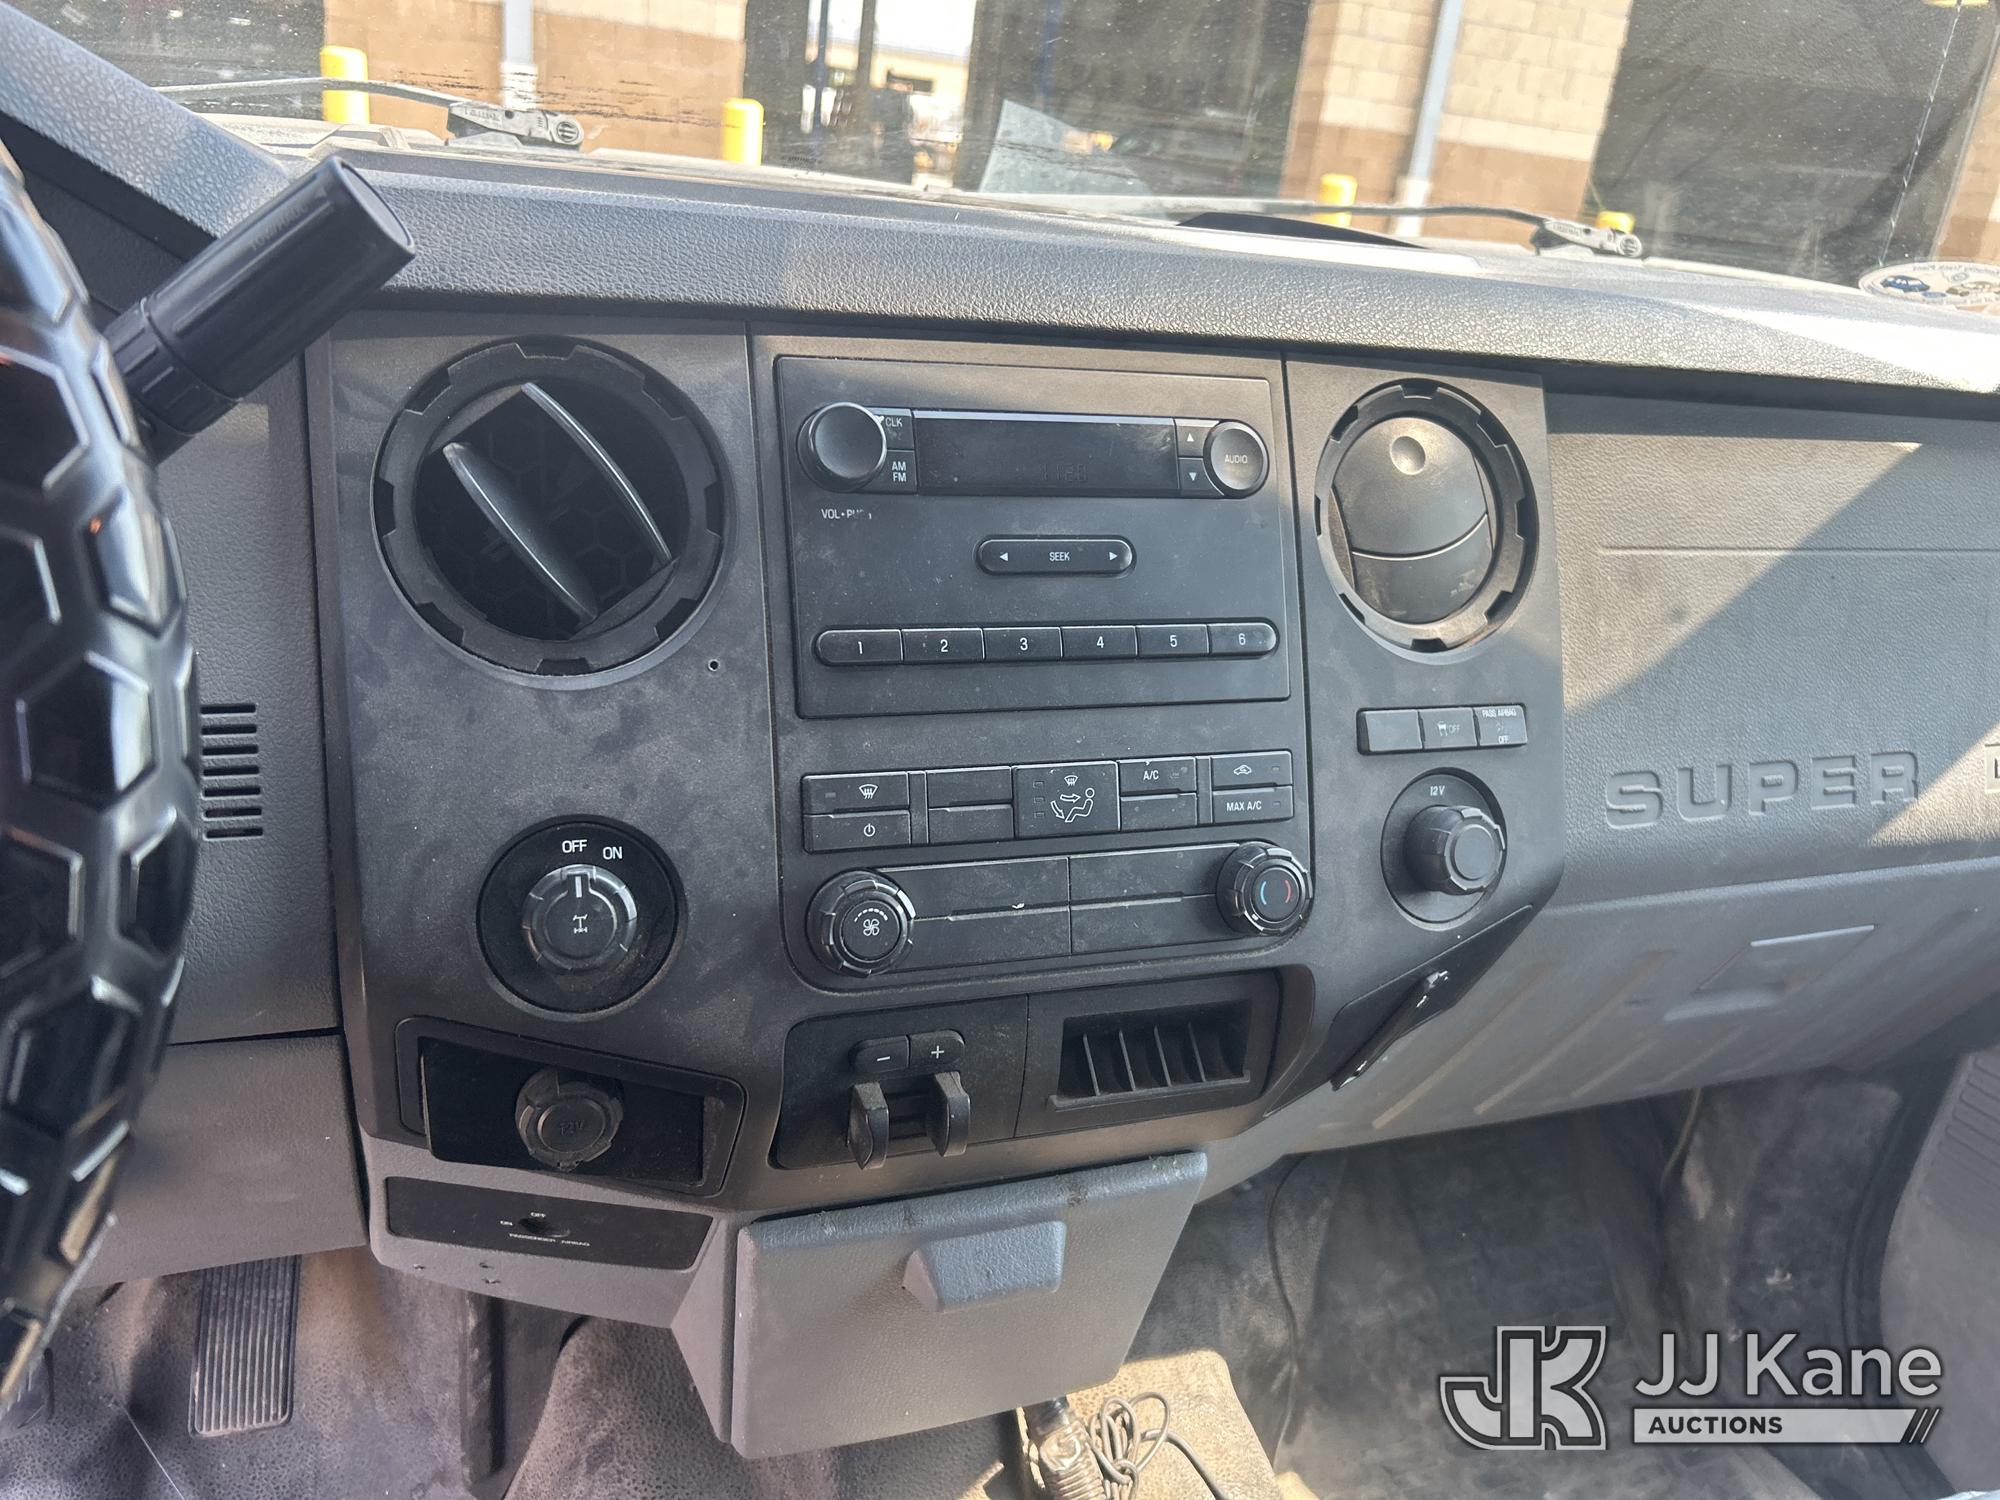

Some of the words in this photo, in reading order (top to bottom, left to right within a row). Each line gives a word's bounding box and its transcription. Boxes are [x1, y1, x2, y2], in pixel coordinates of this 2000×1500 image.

[885, 417, 903, 428] CLK
[1224, 454, 1248, 464] AUDIO
[891, 461, 907, 471] AM
[892, 472, 907, 482] FM
[1049, 552, 1070, 561] SEEK
[1019, 637, 1028, 651] 3
[1096, 636, 1105, 649] 4
[1169, 635, 1178, 648] 5
[1238, 633, 1247, 646] 6
[857, 641, 863, 654] 1
[940, 639, 949, 653] 2
[1482, 709, 1497, 718] PASS
[1498, 735, 1509, 744] OFF
[1143, 770, 1160, 781] A/C
[1430, 785, 1445, 796] 12V
[1605, 750, 1919, 830] SUPER
[1226, 802, 1245, 812] MAX
[1246, 800, 1262, 811] A/C
[562, 839, 587, 853] OFF
[602, 846, 623, 860] ON
